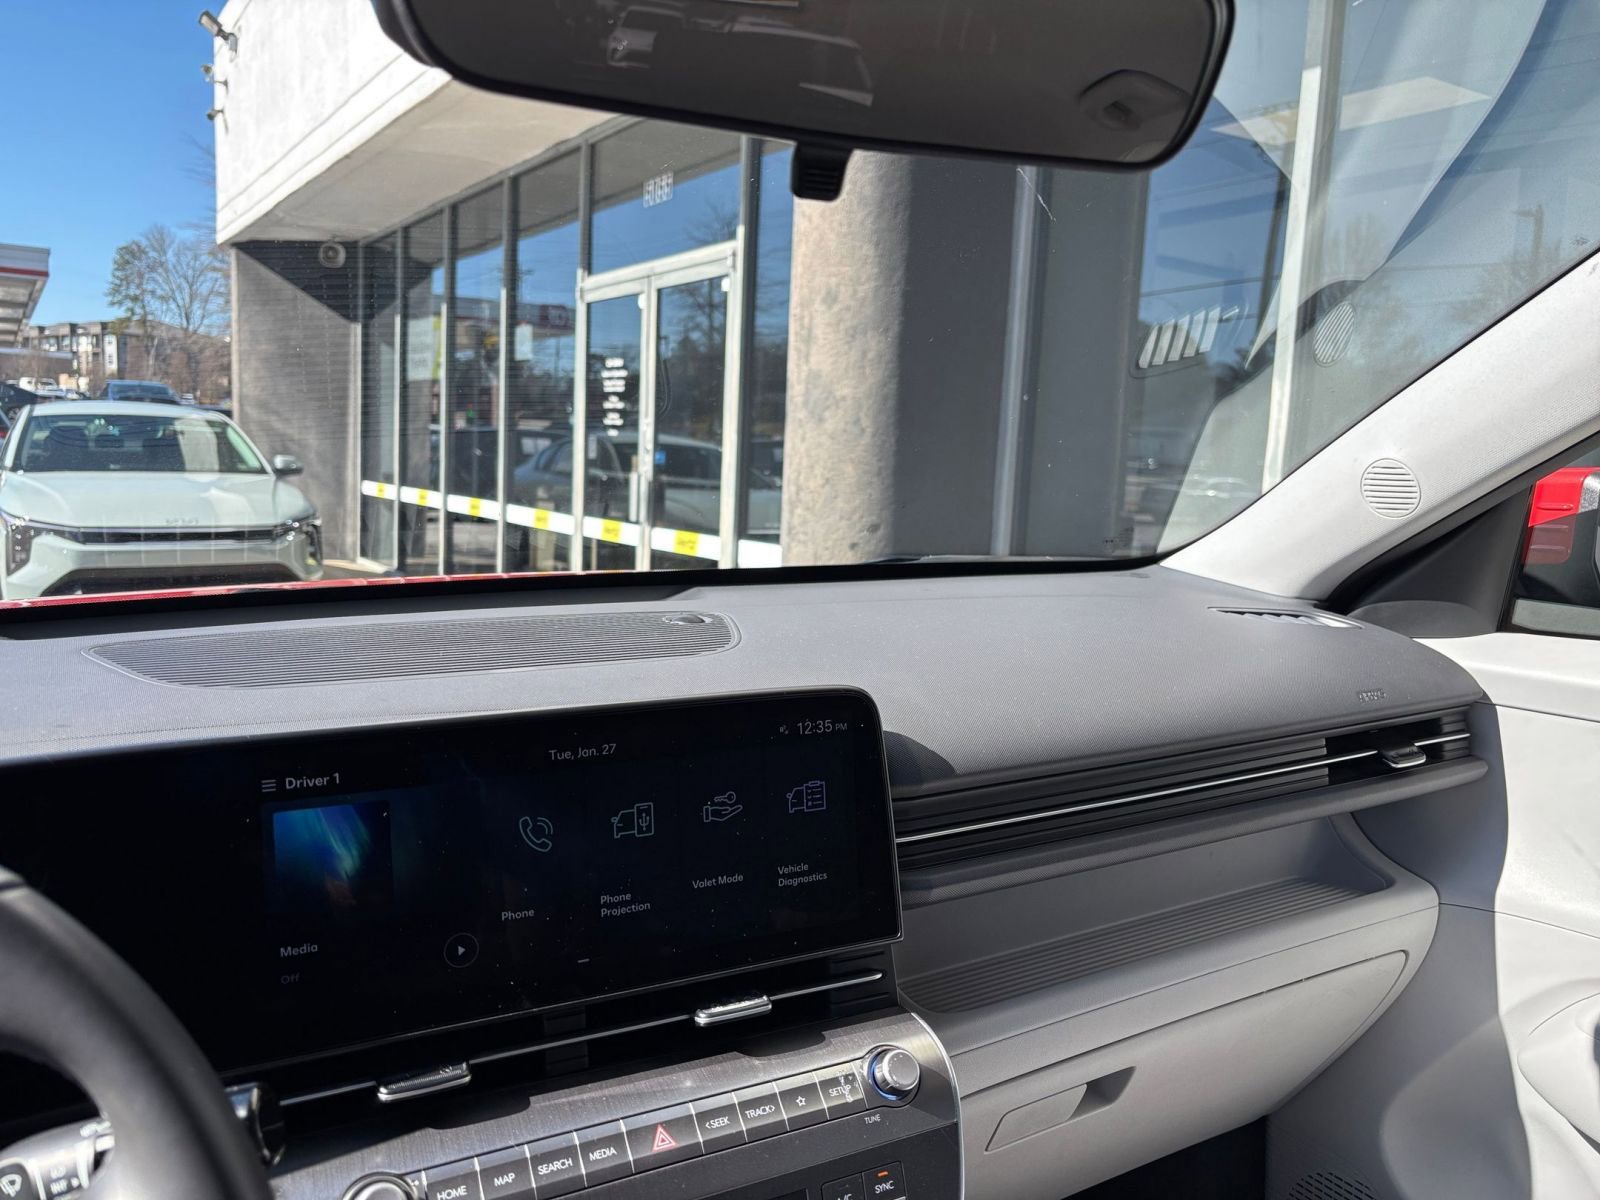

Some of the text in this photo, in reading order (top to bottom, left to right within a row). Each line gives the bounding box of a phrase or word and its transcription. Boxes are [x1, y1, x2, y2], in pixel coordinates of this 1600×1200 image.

[797, 719, 848, 735] 12:35 PM
[548, 743, 617, 761] Tue, Jan. 27
[285, 772, 341, 790] Driver 1
[777, 862, 809, 875] Vehicle
[692, 873, 744, 889] Valet Mode
[777, 872, 828, 887] Diagnostics
[600, 891, 631, 904] Phone
[501, 907, 535, 921] Phone
[600, 902, 651, 917] Projection
[279, 941, 318, 958] Media
[280, 972, 301, 985] Off
[828, 1083, 852, 1098] SETUP
[864, 1114, 881, 1125] TUNE
[588, 1146, 618, 1162] MEDIA
[537, 1157, 574, 1176] SEARCH
[493, 1172, 516, 1187] MAP
[874, 1180, 895, 1194] SYNC
[436, 1184, 468, 1200] HOME
